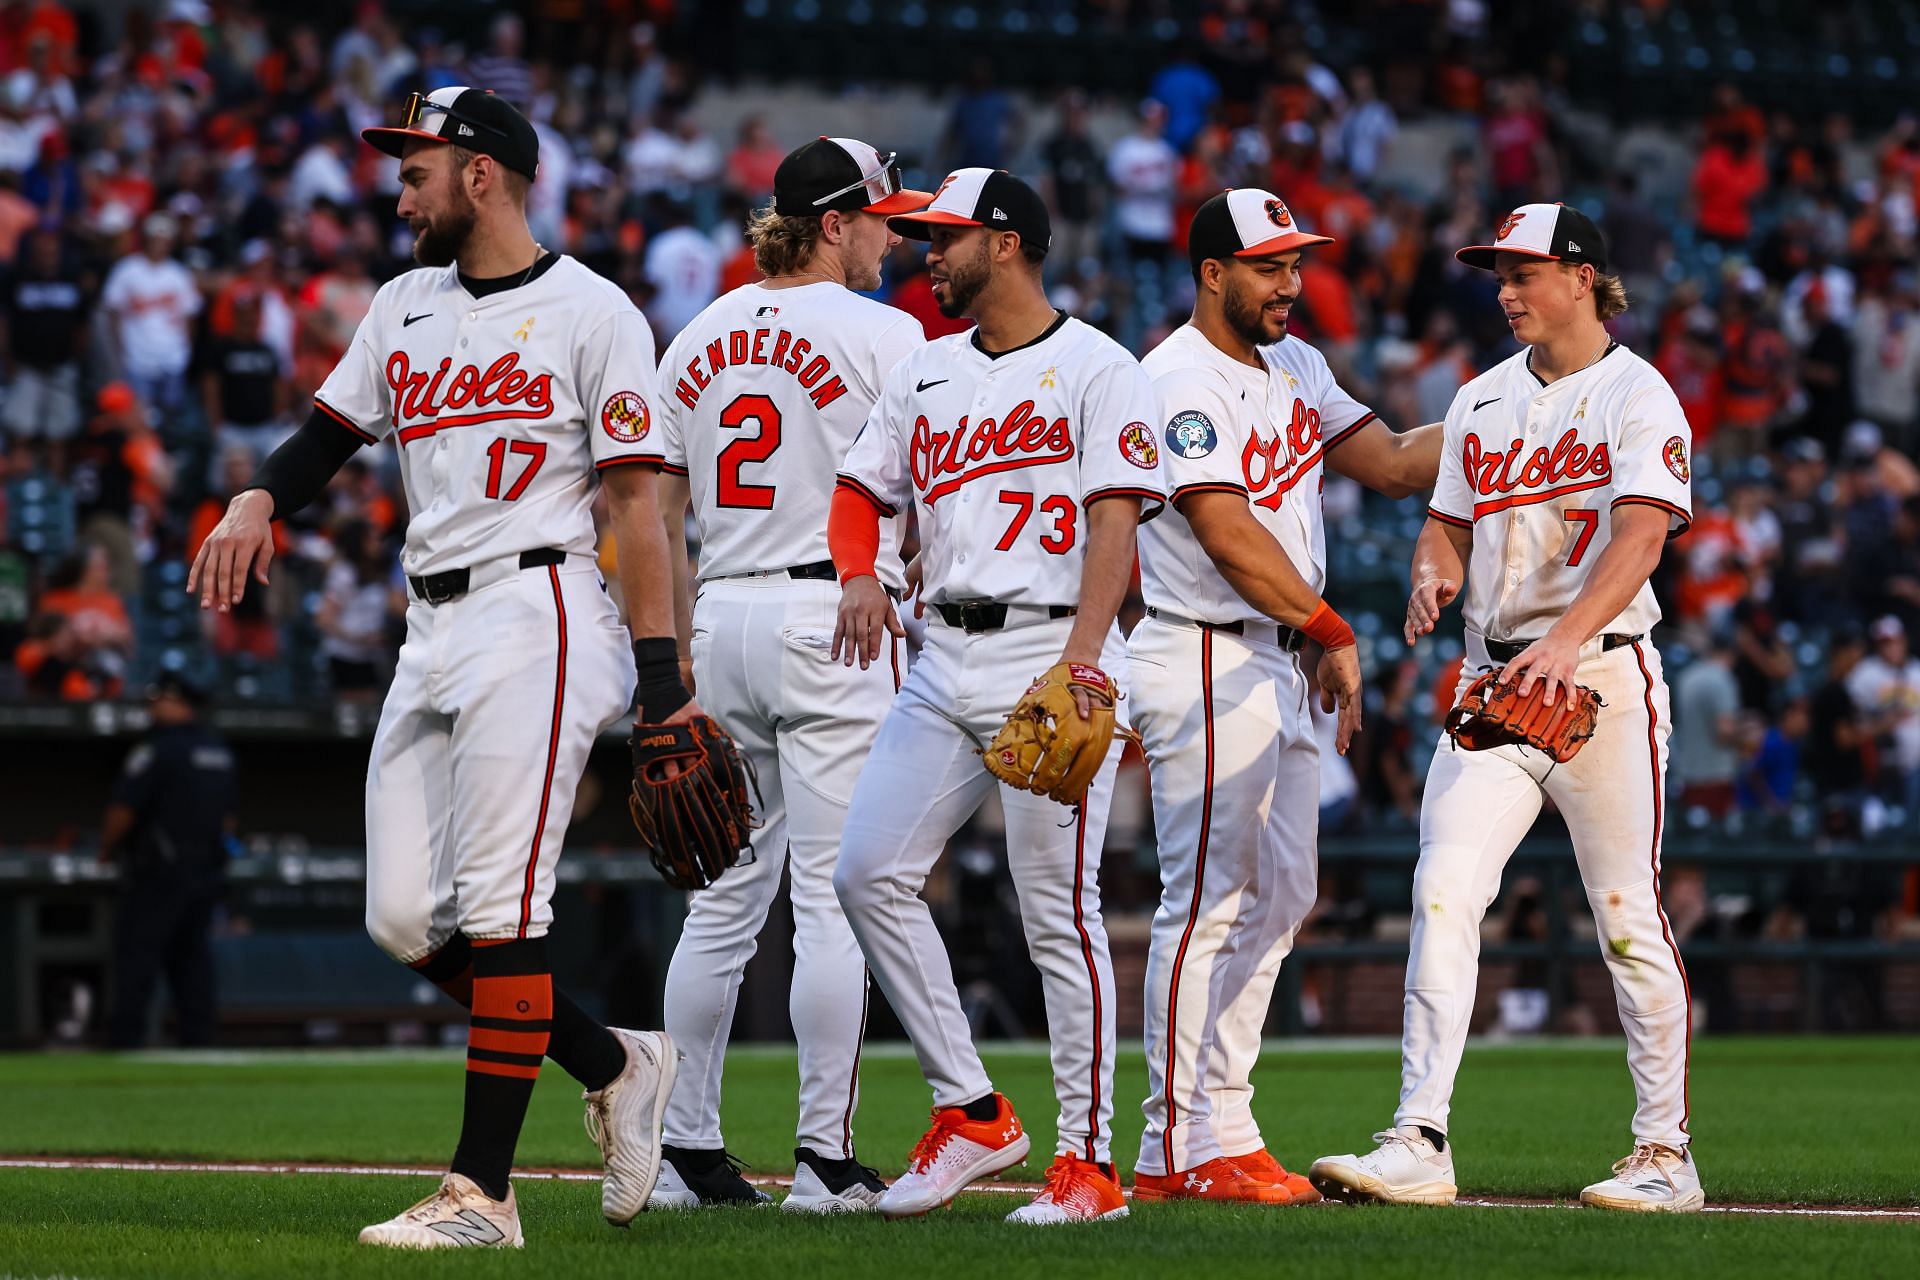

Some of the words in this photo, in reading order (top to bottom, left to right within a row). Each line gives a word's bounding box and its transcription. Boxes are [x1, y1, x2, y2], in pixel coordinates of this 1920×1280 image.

[386, 350, 554, 428] Orioles
[675, 328, 848, 411] HENDERSON
[716, 393, 782, 510] 2
[910, 399, 1074, 491] Orioles
[1173, 413, 1197, 426] Rowe
[1197, 412, 1212, 431] Price
[485, 437, 547, 502] 17
[1463, 428, 1612, 495] Orioles
[994, 489, 1078, 556] 73
[1563, 508, 1599, 567] 7
